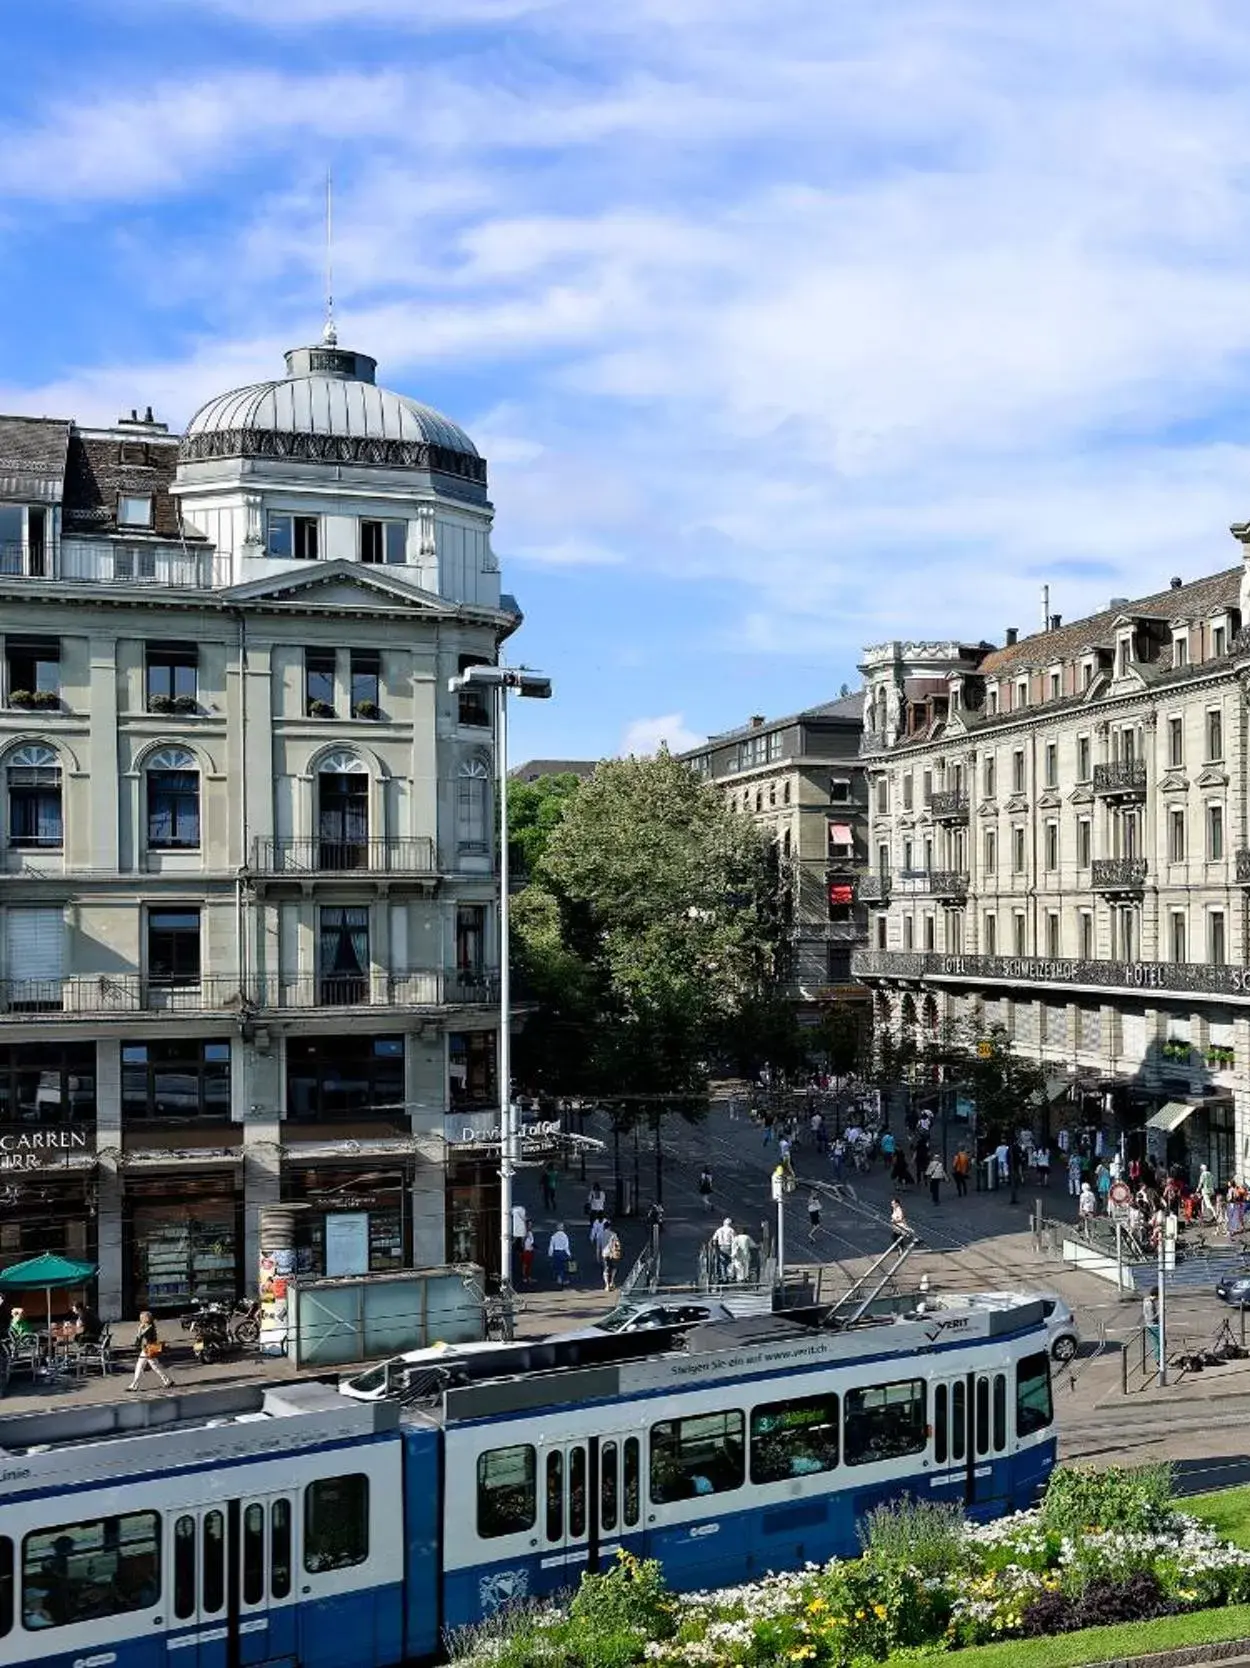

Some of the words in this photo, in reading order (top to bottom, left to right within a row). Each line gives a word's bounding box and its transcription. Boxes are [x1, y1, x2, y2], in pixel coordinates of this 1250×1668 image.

[1002, 960, 1078, 980] SCHWEIZERHOF
[1126, 965, 1164, 986] HOTEL
[764, 1343, 828, 1361] www.verit.ch
